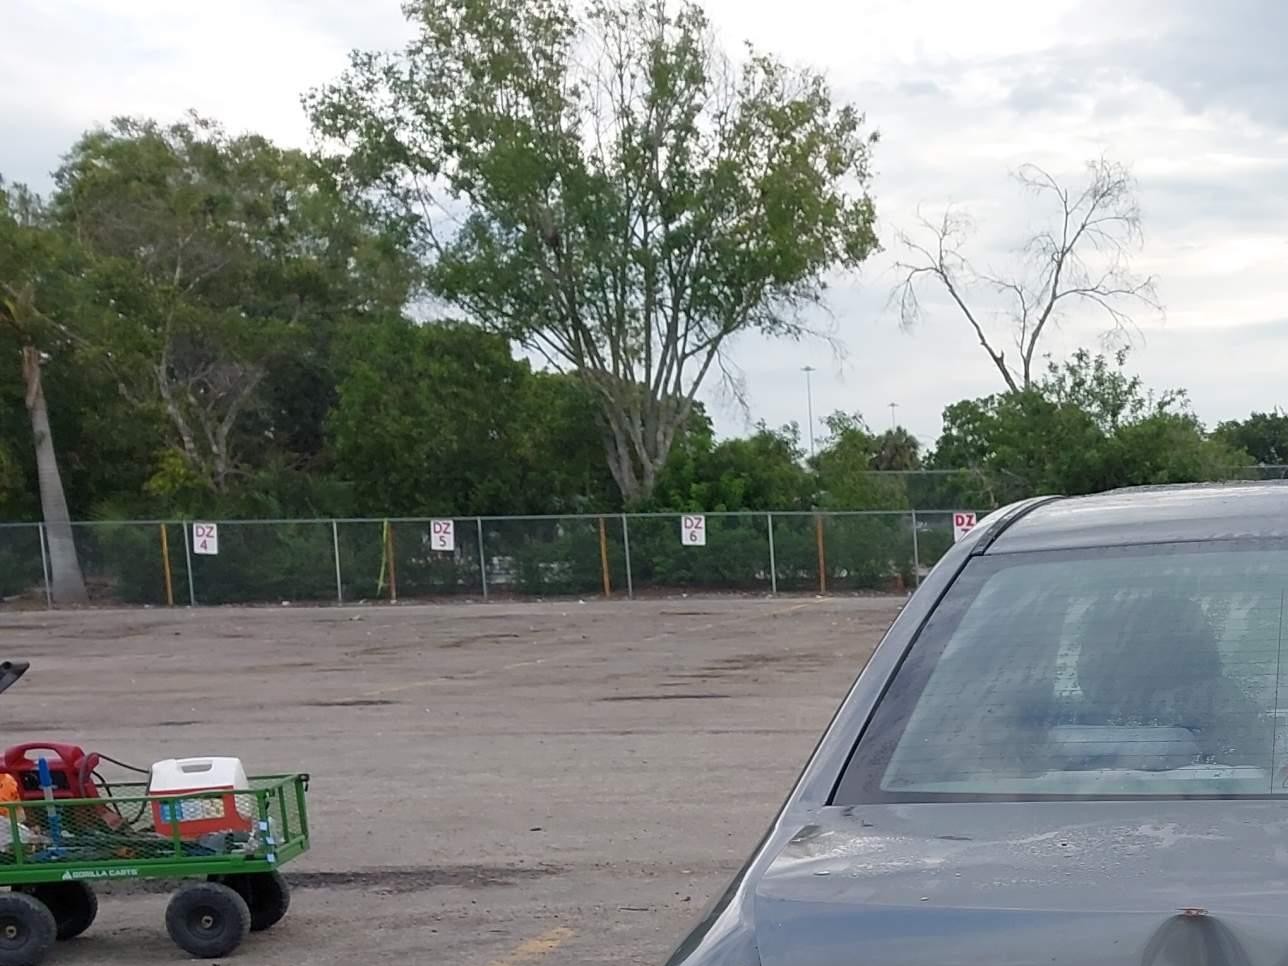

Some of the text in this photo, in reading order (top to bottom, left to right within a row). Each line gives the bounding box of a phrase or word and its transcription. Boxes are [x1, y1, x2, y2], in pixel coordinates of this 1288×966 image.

[684, 517, 703, 530] DZ
[955, 514, 975, 527] DZ
[195, 526, 214, 538] DZ
[433, 522, 452, 534] DZ
[439, 535, 447, 547] 5
[689, 530, 698, 542] 6
[200, 539, 208, 551] 4
